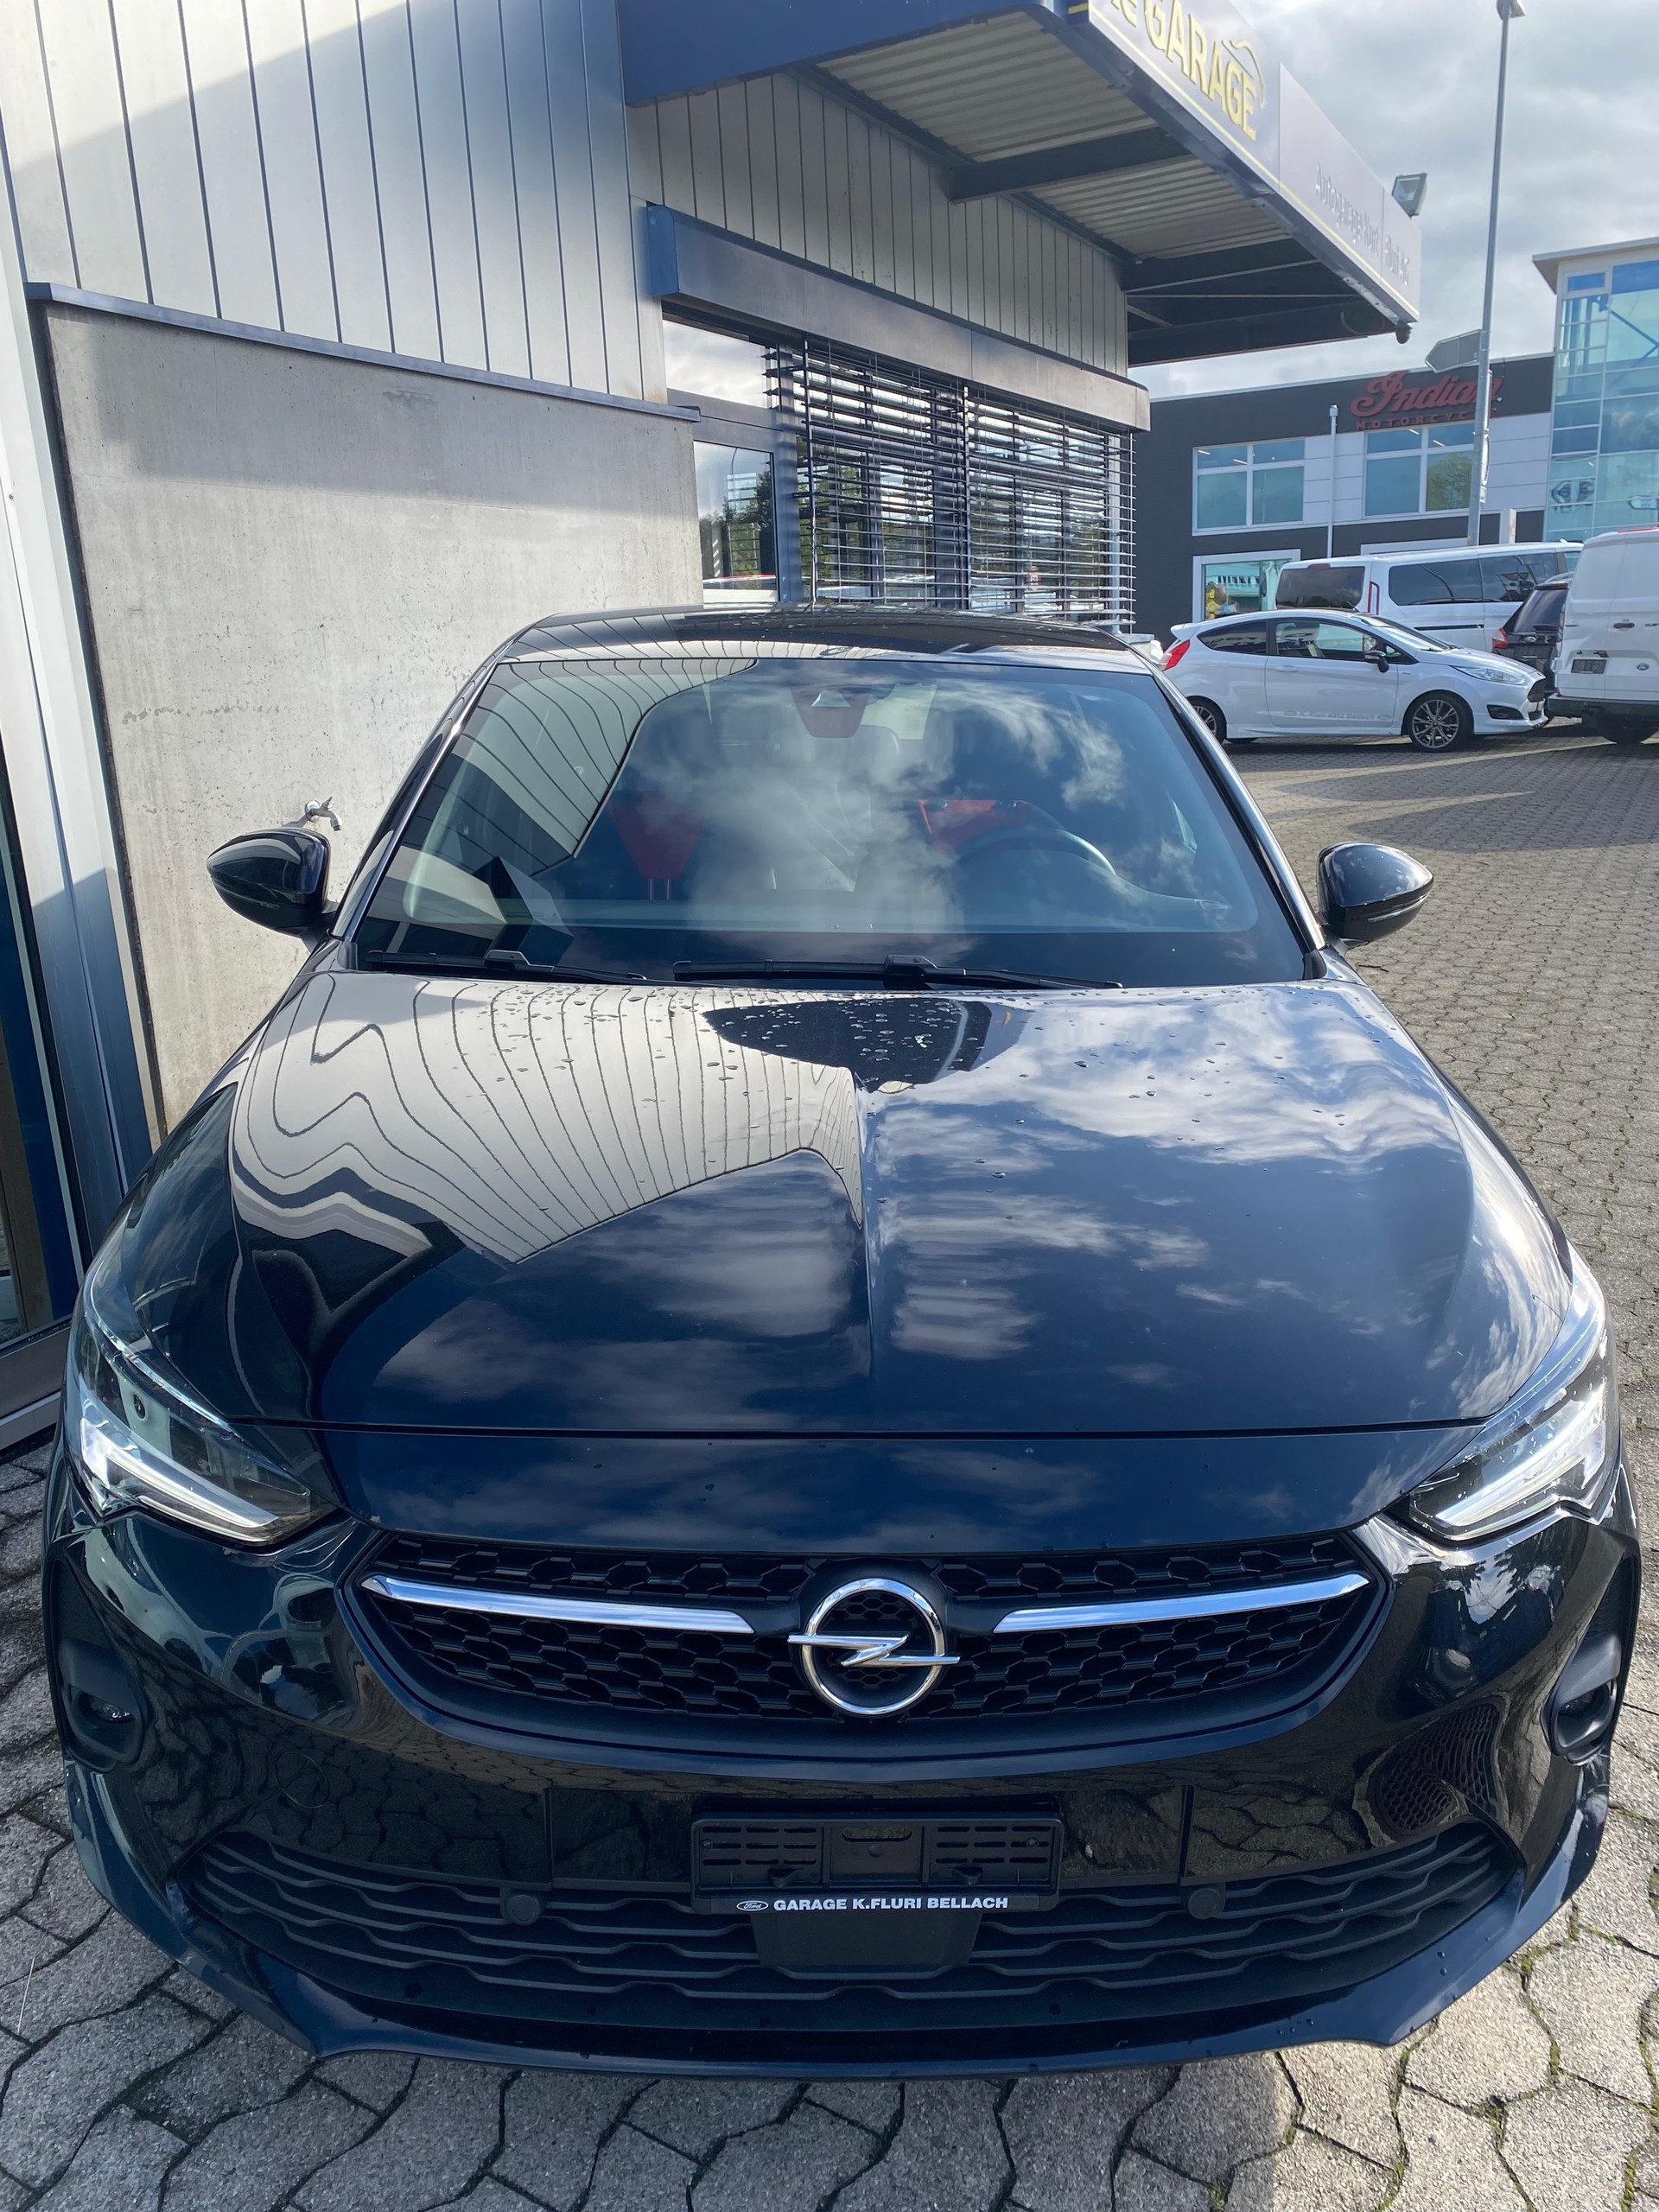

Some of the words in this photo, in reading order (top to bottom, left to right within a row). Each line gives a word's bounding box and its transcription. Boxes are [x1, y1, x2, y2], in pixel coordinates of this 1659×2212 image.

[1143, 0, 1255, 142] GARAGE
[773, 1899, 848, 1911] GARAGE
[852, 1897, 922, 1910] K.FLURI
[927, 1897, 1008, 1909] BELLACH
